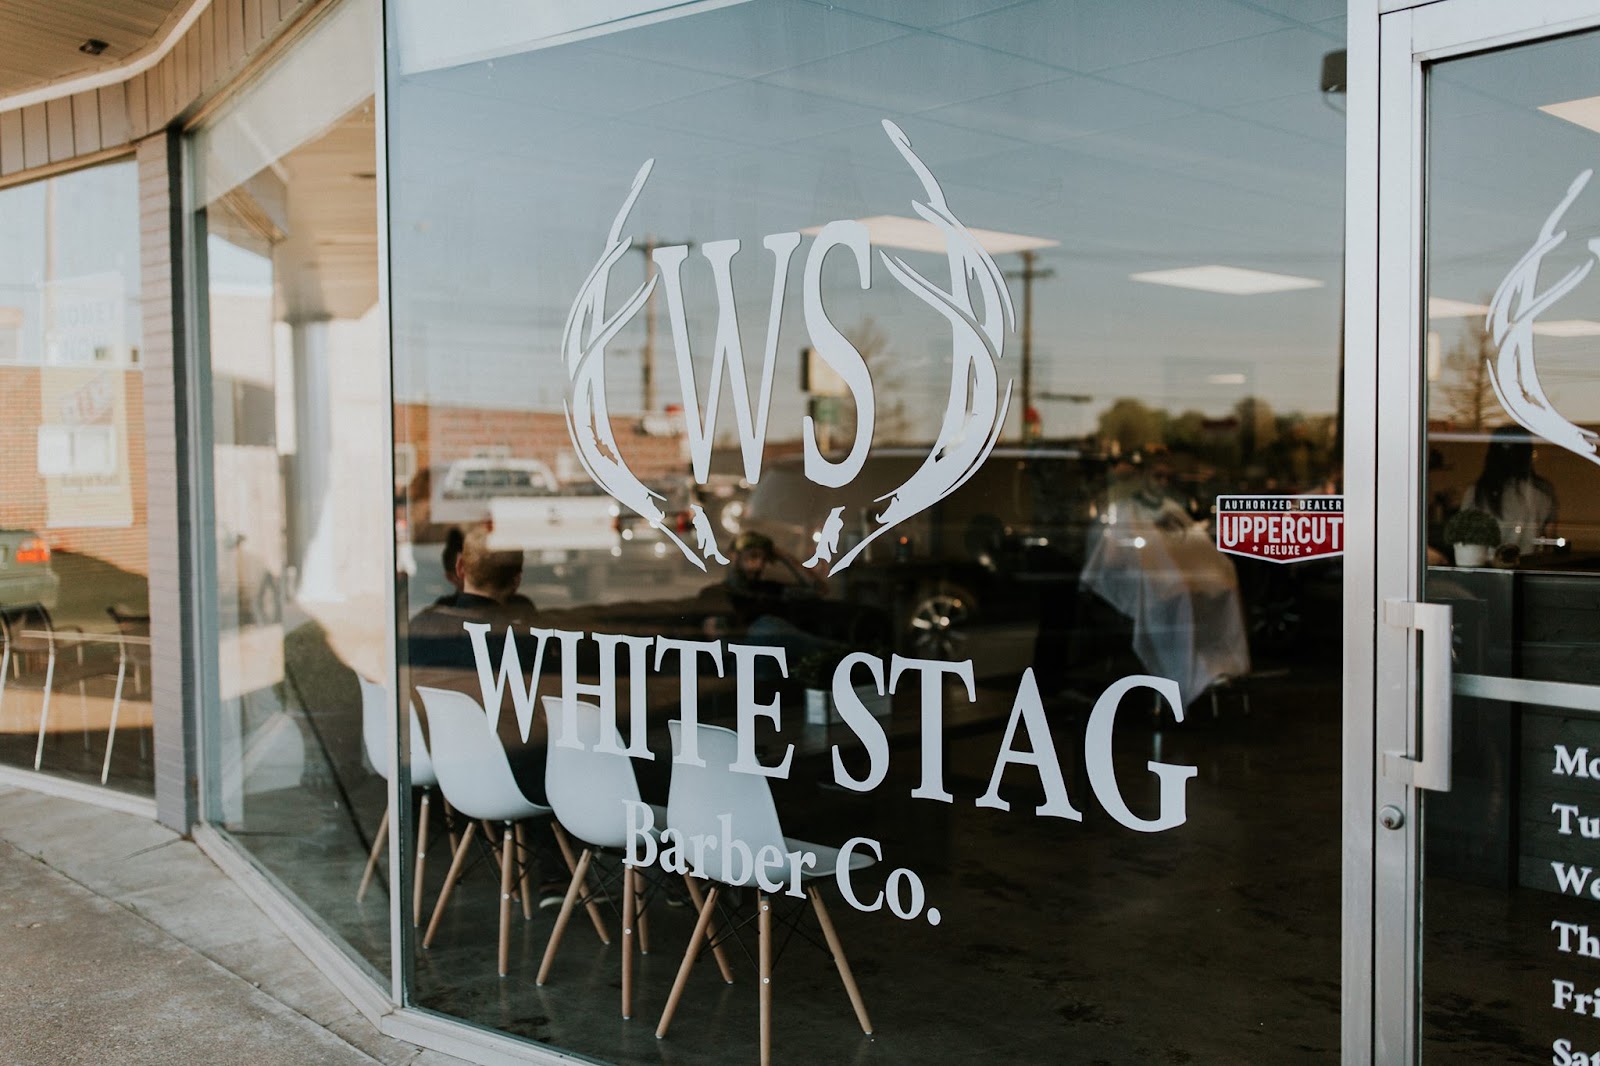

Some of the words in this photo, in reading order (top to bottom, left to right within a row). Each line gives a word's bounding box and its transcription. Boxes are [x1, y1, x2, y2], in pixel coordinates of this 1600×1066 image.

[652, 220, 876, 488] WS
[1225, 500, 1292, 511] AUTHORIZED
[1300, 500, 1342, 511] DEALER
[1223, 516, 1343, 549] UPPERCUT
[1264, 545, 1300, 555] DELUXE
[463, 621, 794, 780] WHITE
[831, 651, 1198, 833] STAG
[1551, 802, 1600, 839] Tu
[622, 799, 817, 900] Barber
[836, 836, 942, 926] Co.
[1552, 978, 1600, 1019] Fri
